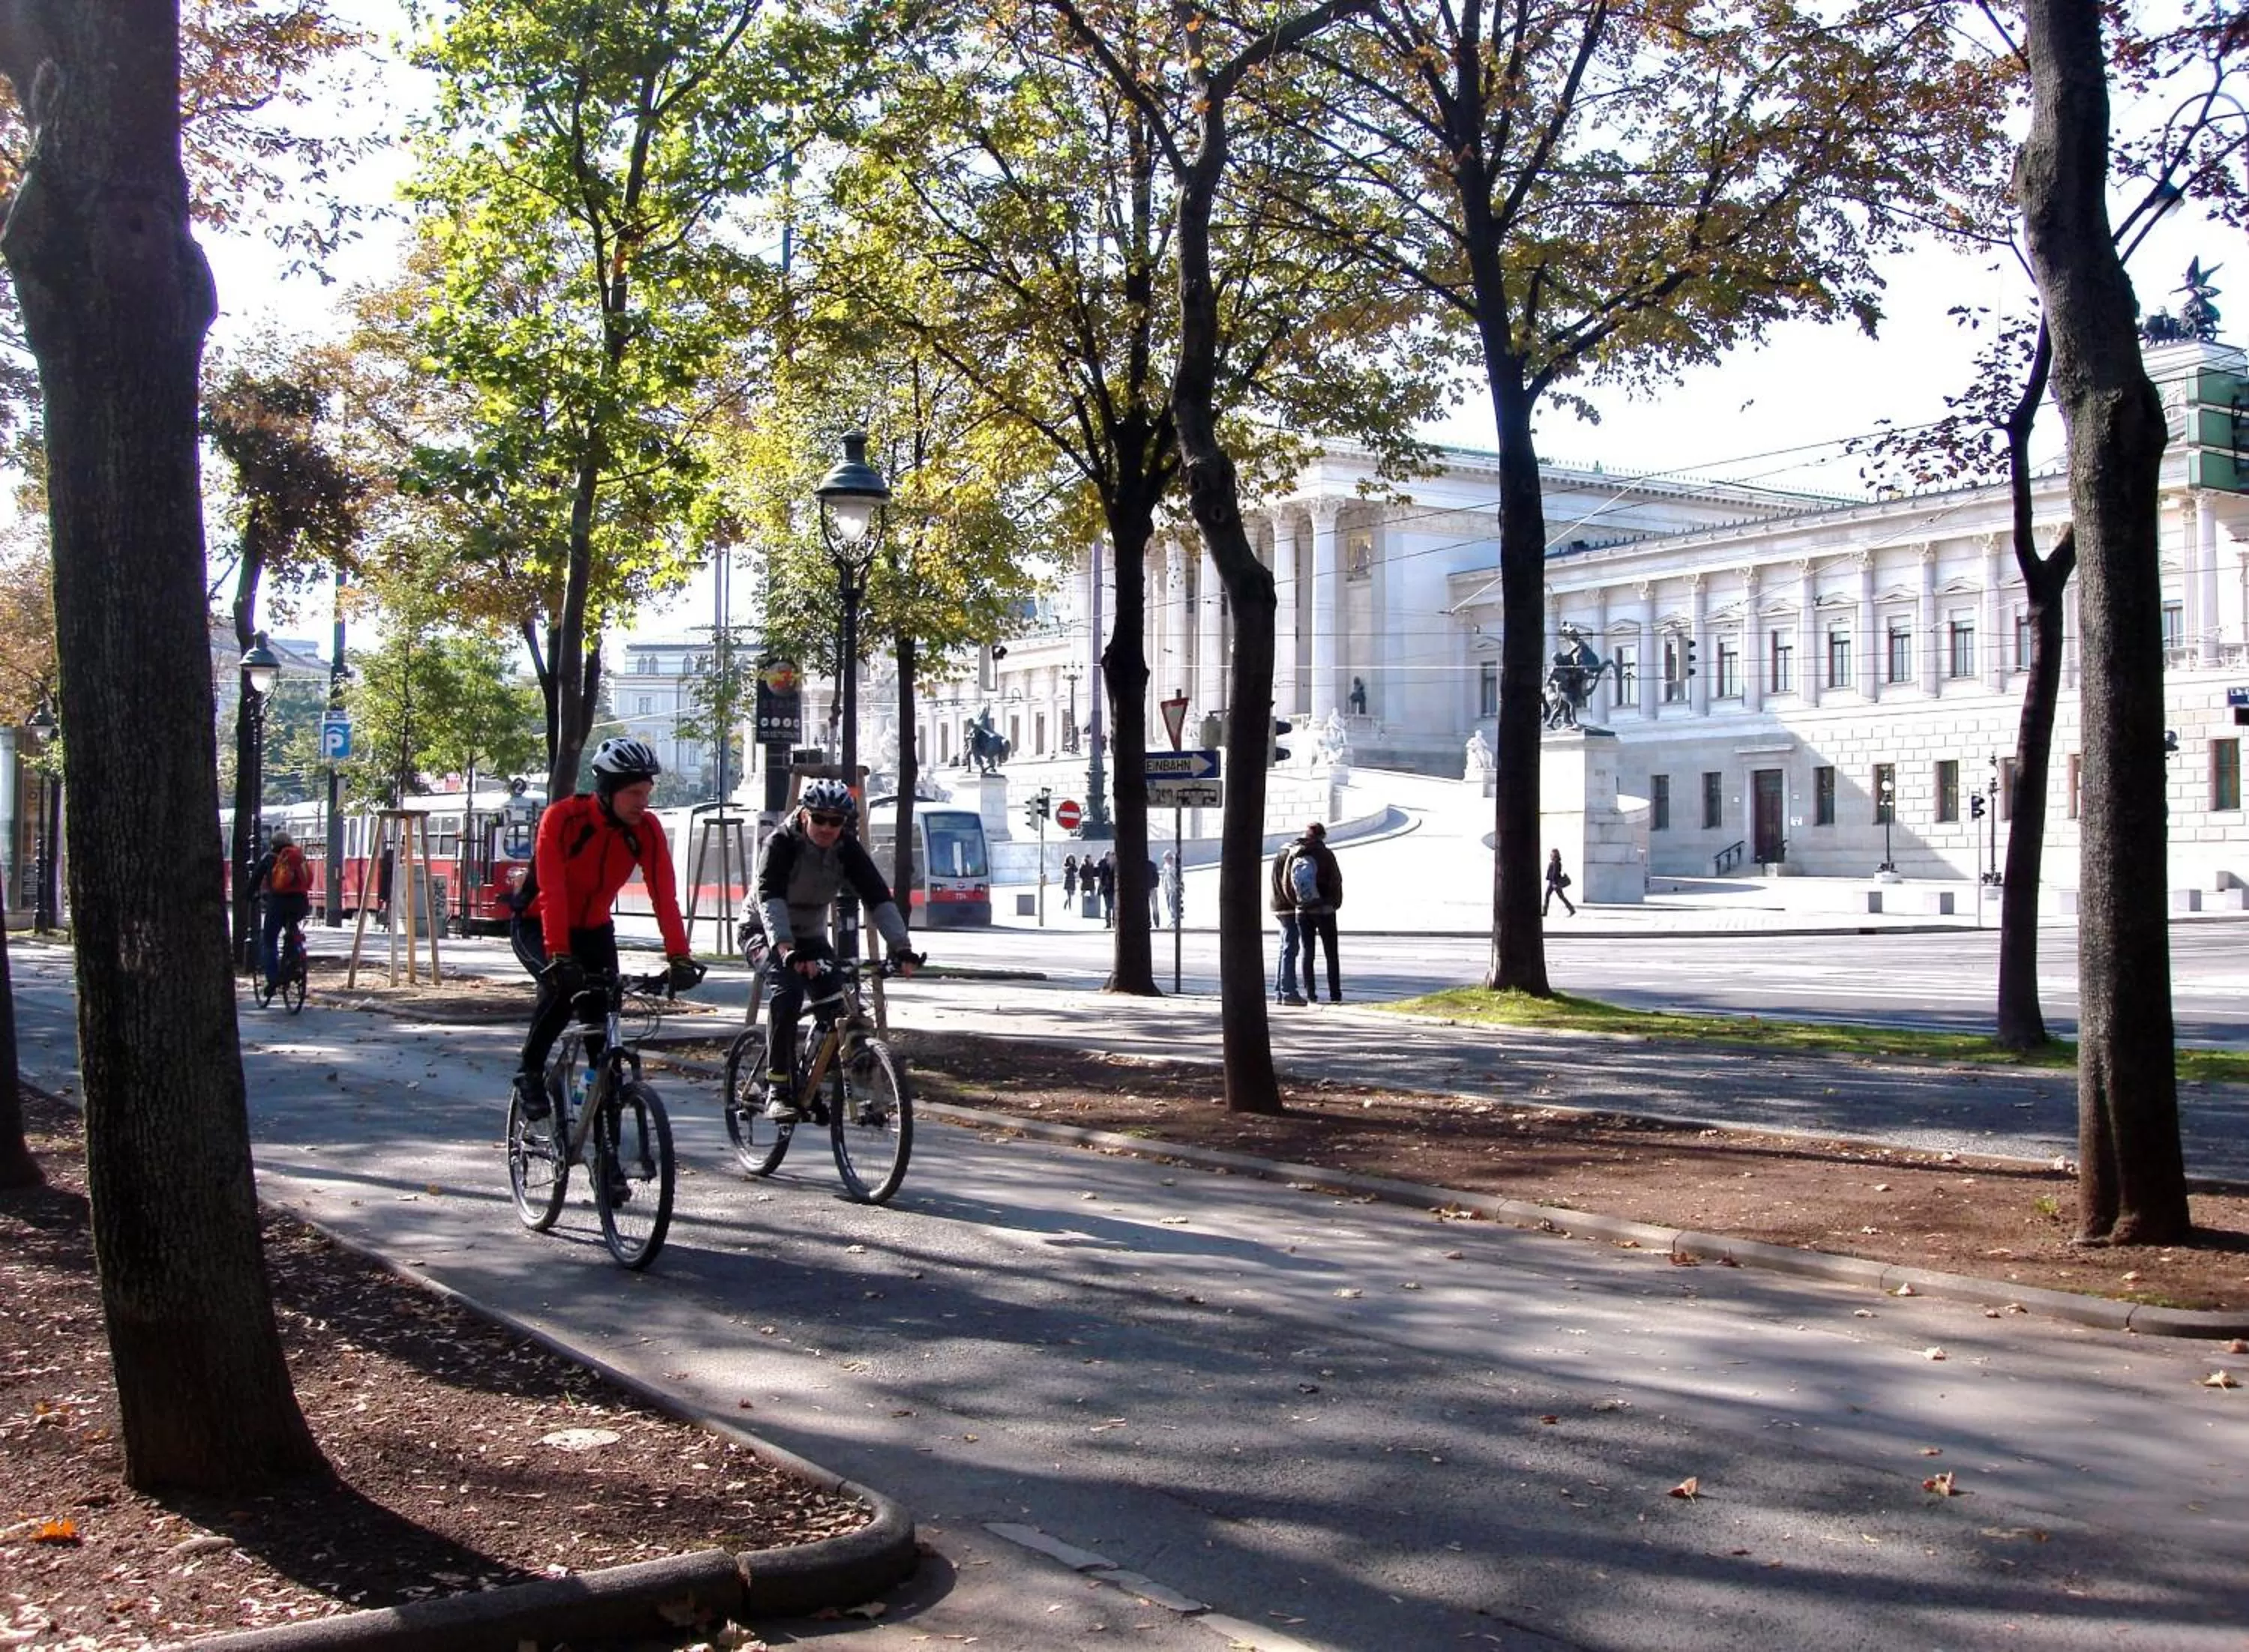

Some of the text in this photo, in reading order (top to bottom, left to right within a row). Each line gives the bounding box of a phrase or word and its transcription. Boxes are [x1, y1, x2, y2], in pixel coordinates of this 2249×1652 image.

[325, 734, 343, 756] P
[1146, 759, 1191, 771] EINBAHN
[515, 780, 523, 794] 2
